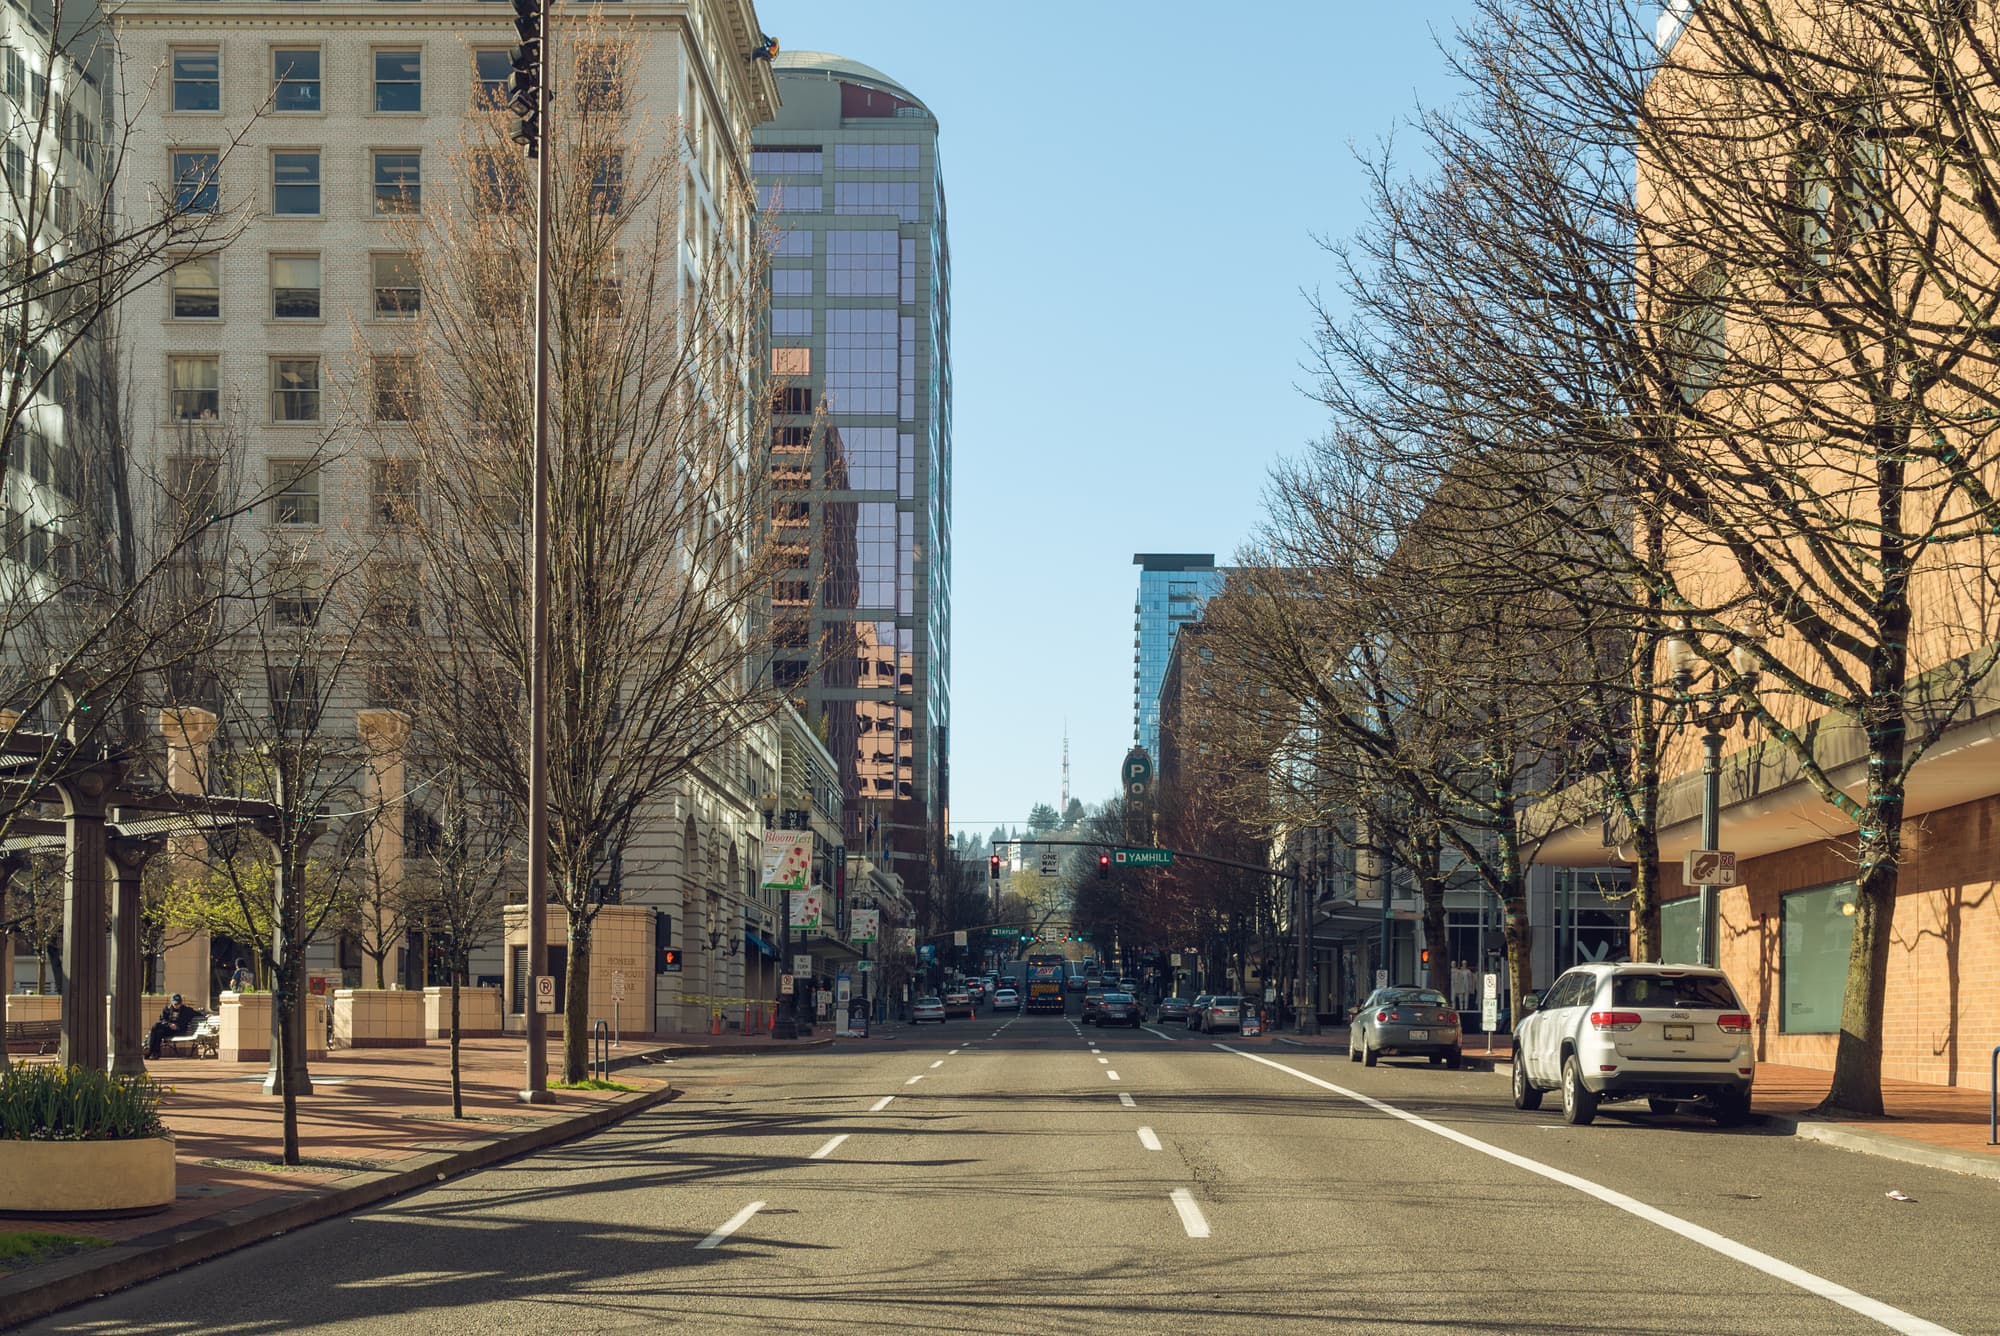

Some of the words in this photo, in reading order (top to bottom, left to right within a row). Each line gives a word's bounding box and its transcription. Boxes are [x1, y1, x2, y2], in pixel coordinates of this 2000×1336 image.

[1041, 853, 1057, 861] ONE
[1128, 852, 1170, 862] YAMHILL
[1721, 855, 1735, 866] 90
